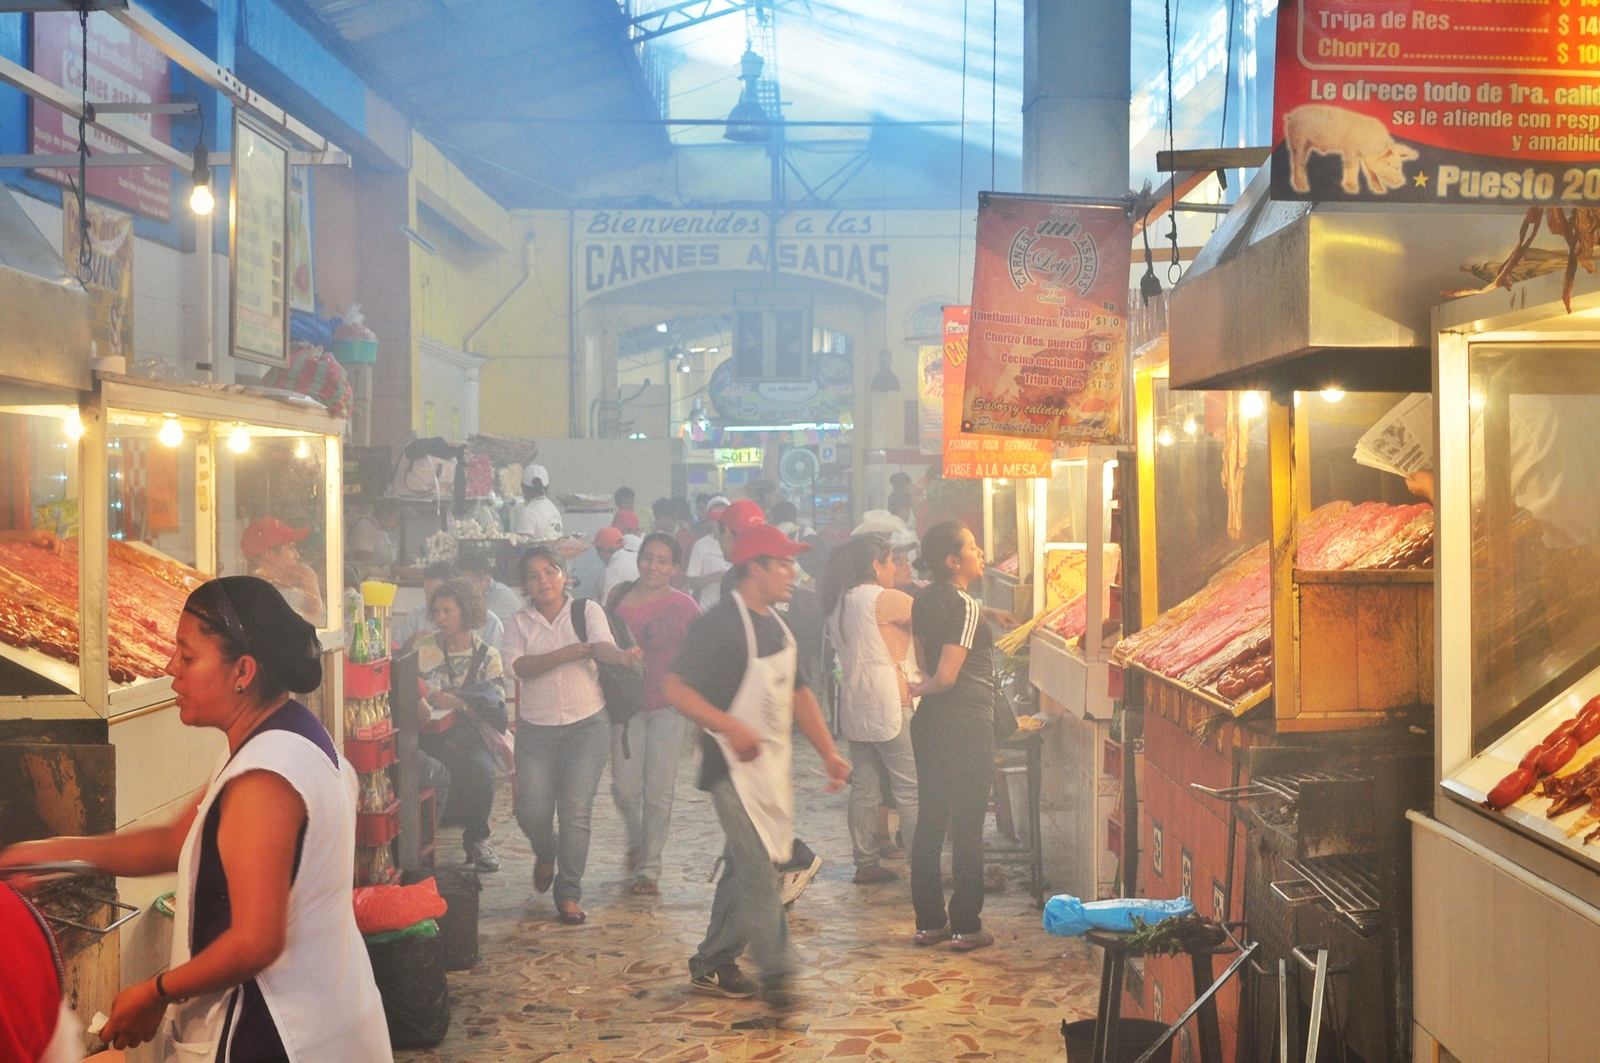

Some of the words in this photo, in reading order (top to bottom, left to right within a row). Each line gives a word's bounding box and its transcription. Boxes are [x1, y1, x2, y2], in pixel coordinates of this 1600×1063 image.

[1319, 10, 1375, 31] Tripa
[1381, 11, 1407, 30] de
[1412, 12, 1450, 31] Res
[1558, 13, 1570, 36] $
[1578, 15, 1600, 36] 14
[1317, 38, 1400, 59] Chorizo
[1557, 42, 1569, 64] $
[1577, 43, 1600, 64] 10
[66, 61, 109, 100] Canes
[1311, 78, 1338, 101] Le
[1342, 81, 1417, 103] ofrece
[1423, 80, 1471, 104] todo
[1476, 82, 1503, 104] de
[1508, 83, 1549, 105] 1ra.
[1391, 110, 1415, 126] se
[1420, 108, 1437, 126] le
[1442, 109, 1513, 128] atiende
[1518, 112, 1551, 128] con
[1556, 112, 1600, 132] resp
[1512, 136, 1522, 152] y
[1437, 164, 1554, 200] Puesto
[586, 209, 761, 235] Bienvenidos
[794, 215, 814, 234] a
[825, 210, 872, 235] las
[585, 243, 721, 293] CARNES
[746, 243, 890, 297] ASADAS
[1012, 234, 1031, 287] CARNES
[1078, 238, 1095, 290] ASADAS
[1059, 306, 1092, 319] Tasajo
[984, 331, 1021, 345] Chorizo
[1047, 338, 1087, 350] puerco)
[1000, 351, 1034, 365] Cecina
[1036, 356, 1086, 370] enchilada
[1024, 373, 1049, 385] Tripa
[1051, 376, 1063, 386] de
[1065, 377, 1085, 388] Res
[971, 398, 1010, 412] Sabor
[1024, 403, 1071, 417] calidad
[976, 464, 983, 477] A
[985, 464, 998, 477] LA
